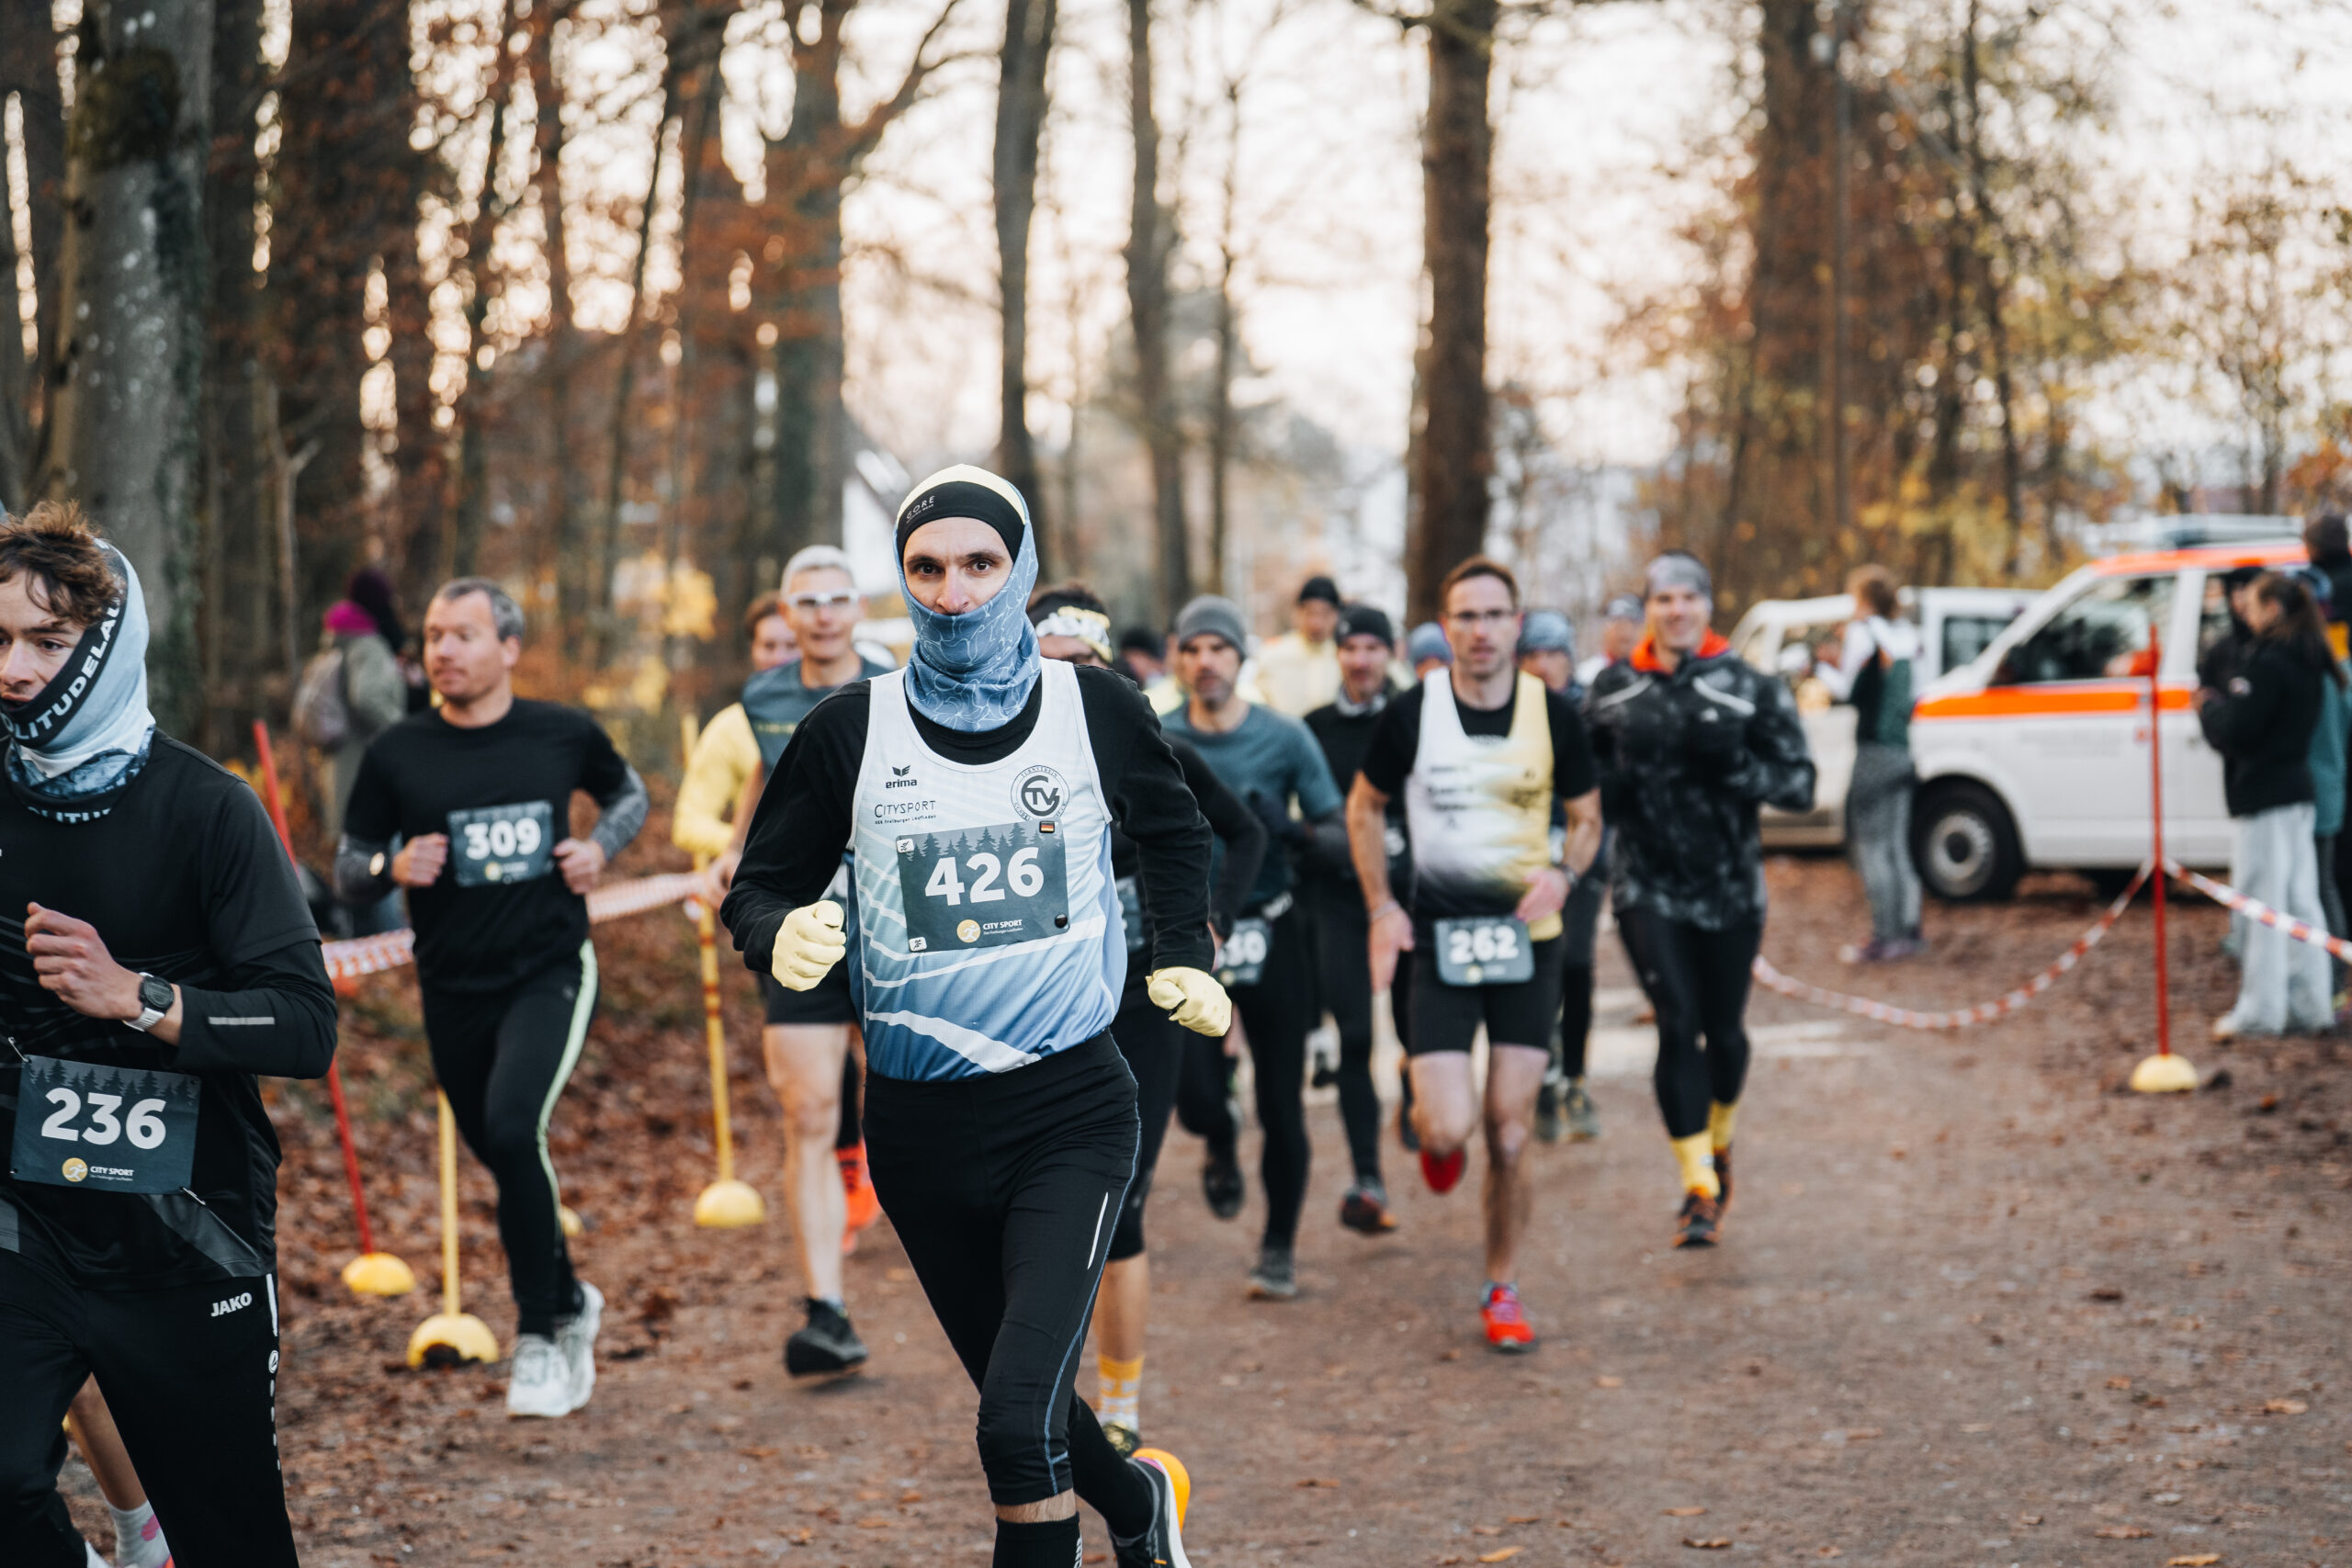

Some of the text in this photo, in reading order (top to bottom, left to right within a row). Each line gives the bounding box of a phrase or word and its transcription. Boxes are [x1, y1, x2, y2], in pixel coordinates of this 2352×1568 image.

[906, 495, 935, 519] GORE
[885, 779, 918, 789] erima
[463, 817, 542, 861] 309
[924, 846, 1045, 906] 426
[982, 919, 1023, 931] CITY SPORT
[1449, 924, 1519, 964] 262
[40, 1088, 167, 1149] 236
[90, 1166, 135, 1177] CITY SPORT
[210, 1292, 253, 1317] JAKO
